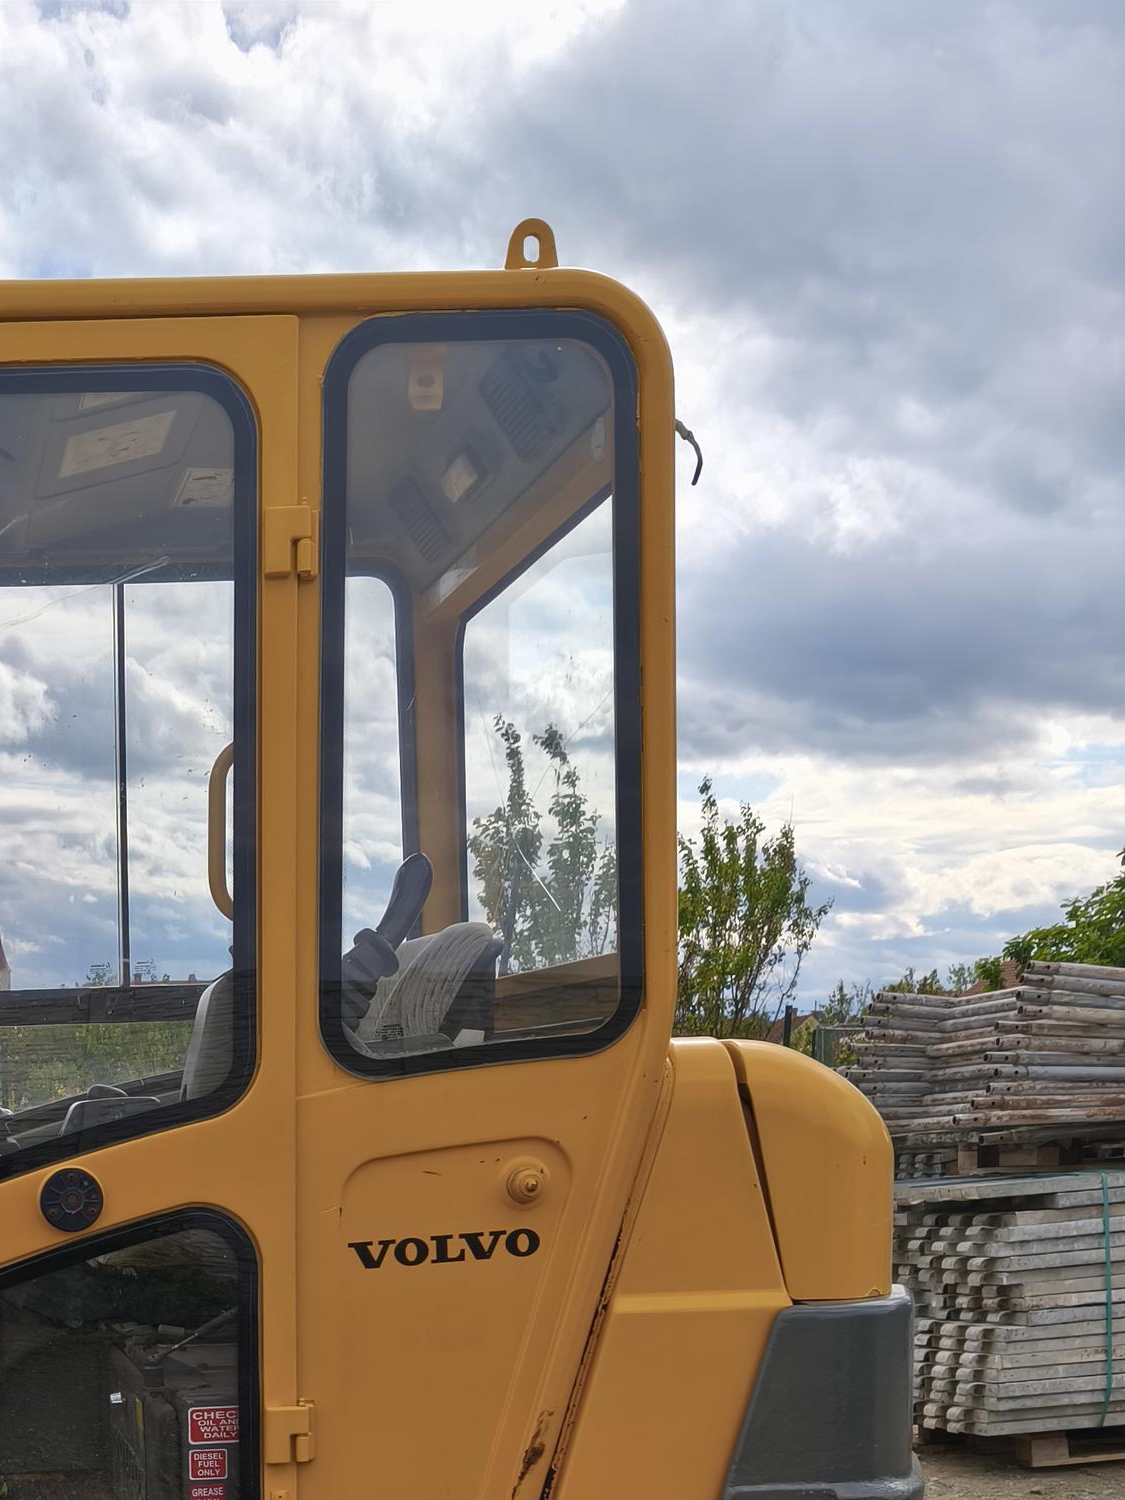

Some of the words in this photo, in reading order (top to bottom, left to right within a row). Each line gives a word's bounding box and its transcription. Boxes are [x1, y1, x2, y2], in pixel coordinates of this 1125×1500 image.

[348, 1228, 540, 1270] VOLVO
[192, 1411, 238, 1420] CHEC
[204, 1431, 237, 1439] DAILY
[193, 1453, 224, 1461] DIESEL
[198, 1460, 220, 1468] FUEL
[191, 1487, 224, 1497] GREASE
